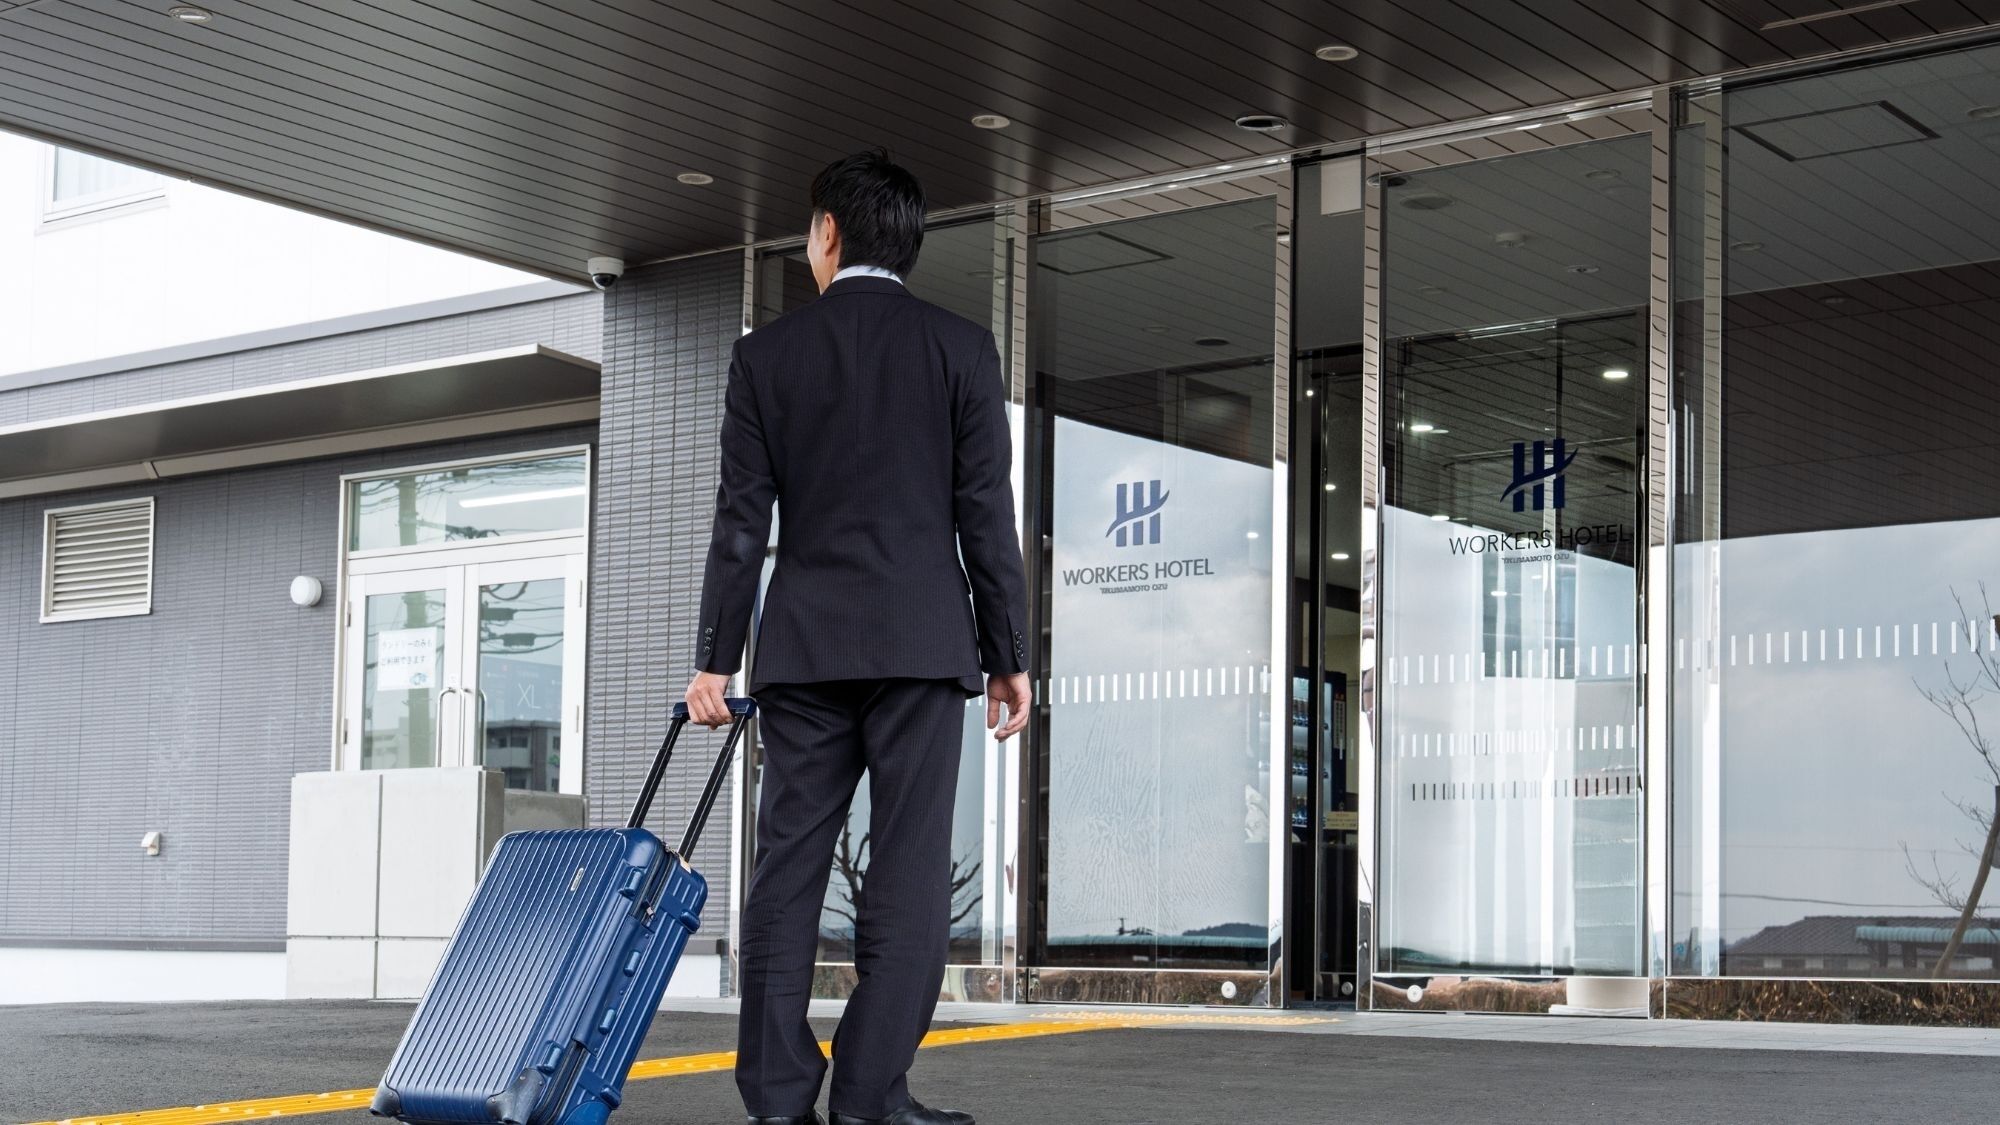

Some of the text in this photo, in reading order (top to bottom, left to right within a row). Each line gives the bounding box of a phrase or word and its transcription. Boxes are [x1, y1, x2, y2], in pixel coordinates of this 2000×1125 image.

[1449, 523, 1631, 555] WORKERS HOTEL
[1063, 558, 1215, 587] WORKERS HOTEL
[517, 682, 542, 710] XL
